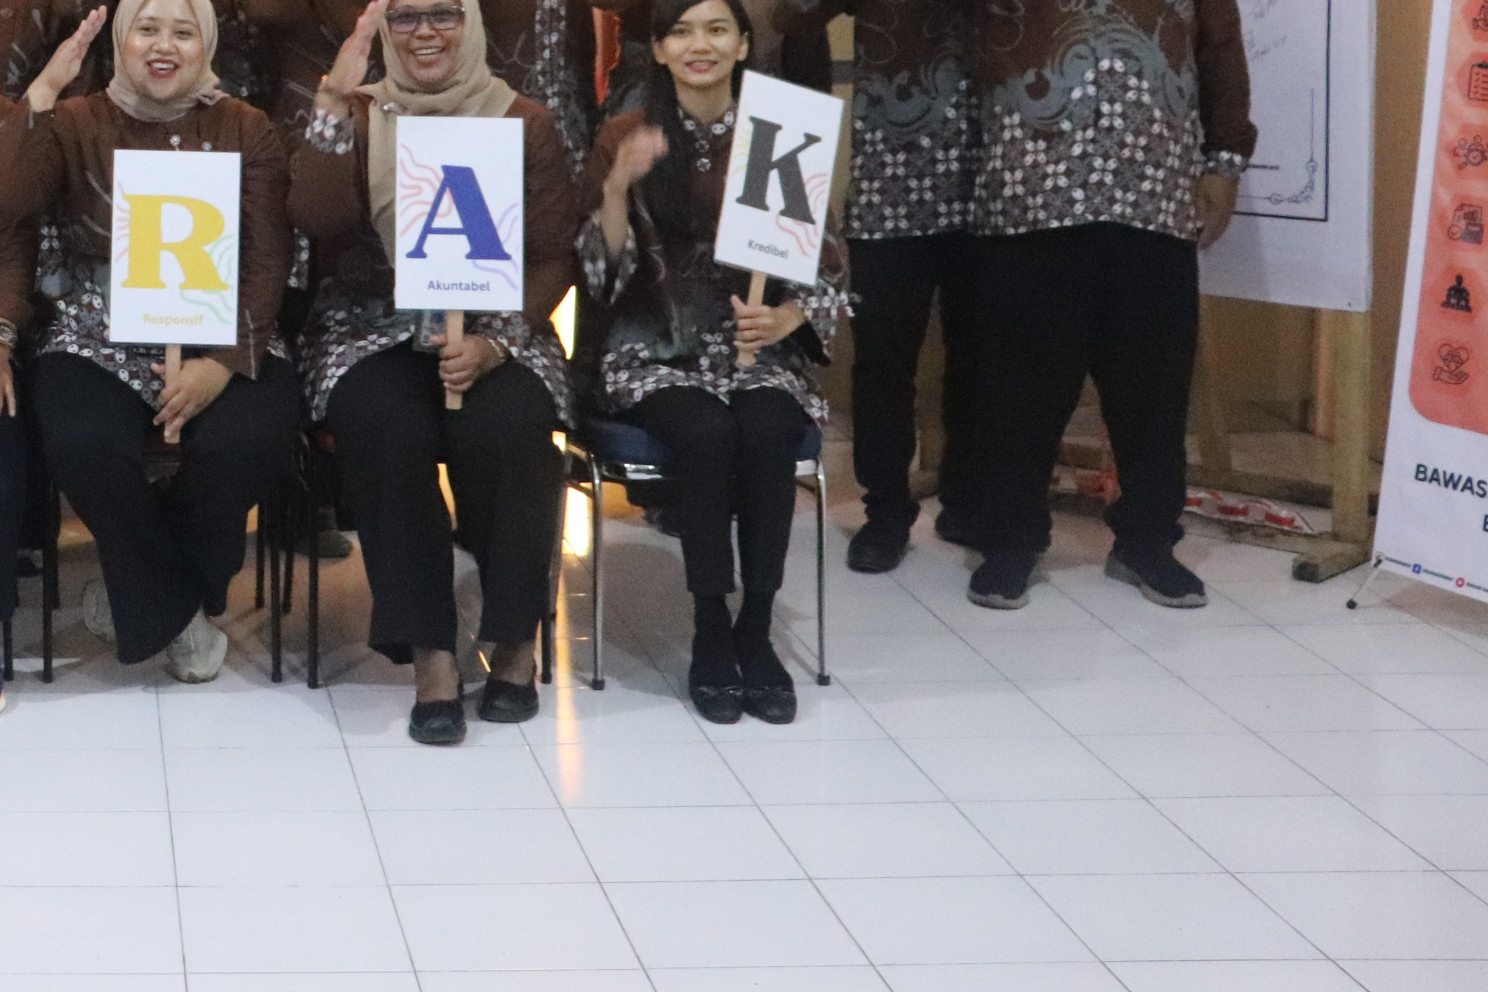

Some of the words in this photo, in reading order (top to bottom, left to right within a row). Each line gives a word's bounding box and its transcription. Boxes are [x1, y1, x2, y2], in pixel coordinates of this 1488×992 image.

[735, 115, 822, 226] K
[405, 164, 513, 261] A
[120, 193, 231, 291] R
[747, 239, 789, 260] Kredibel
[426, 279, 491, 292] Akuntabel
[143, 313, 204, 327] Responsif
[1414, 463, 1488, 499] BAWAS
